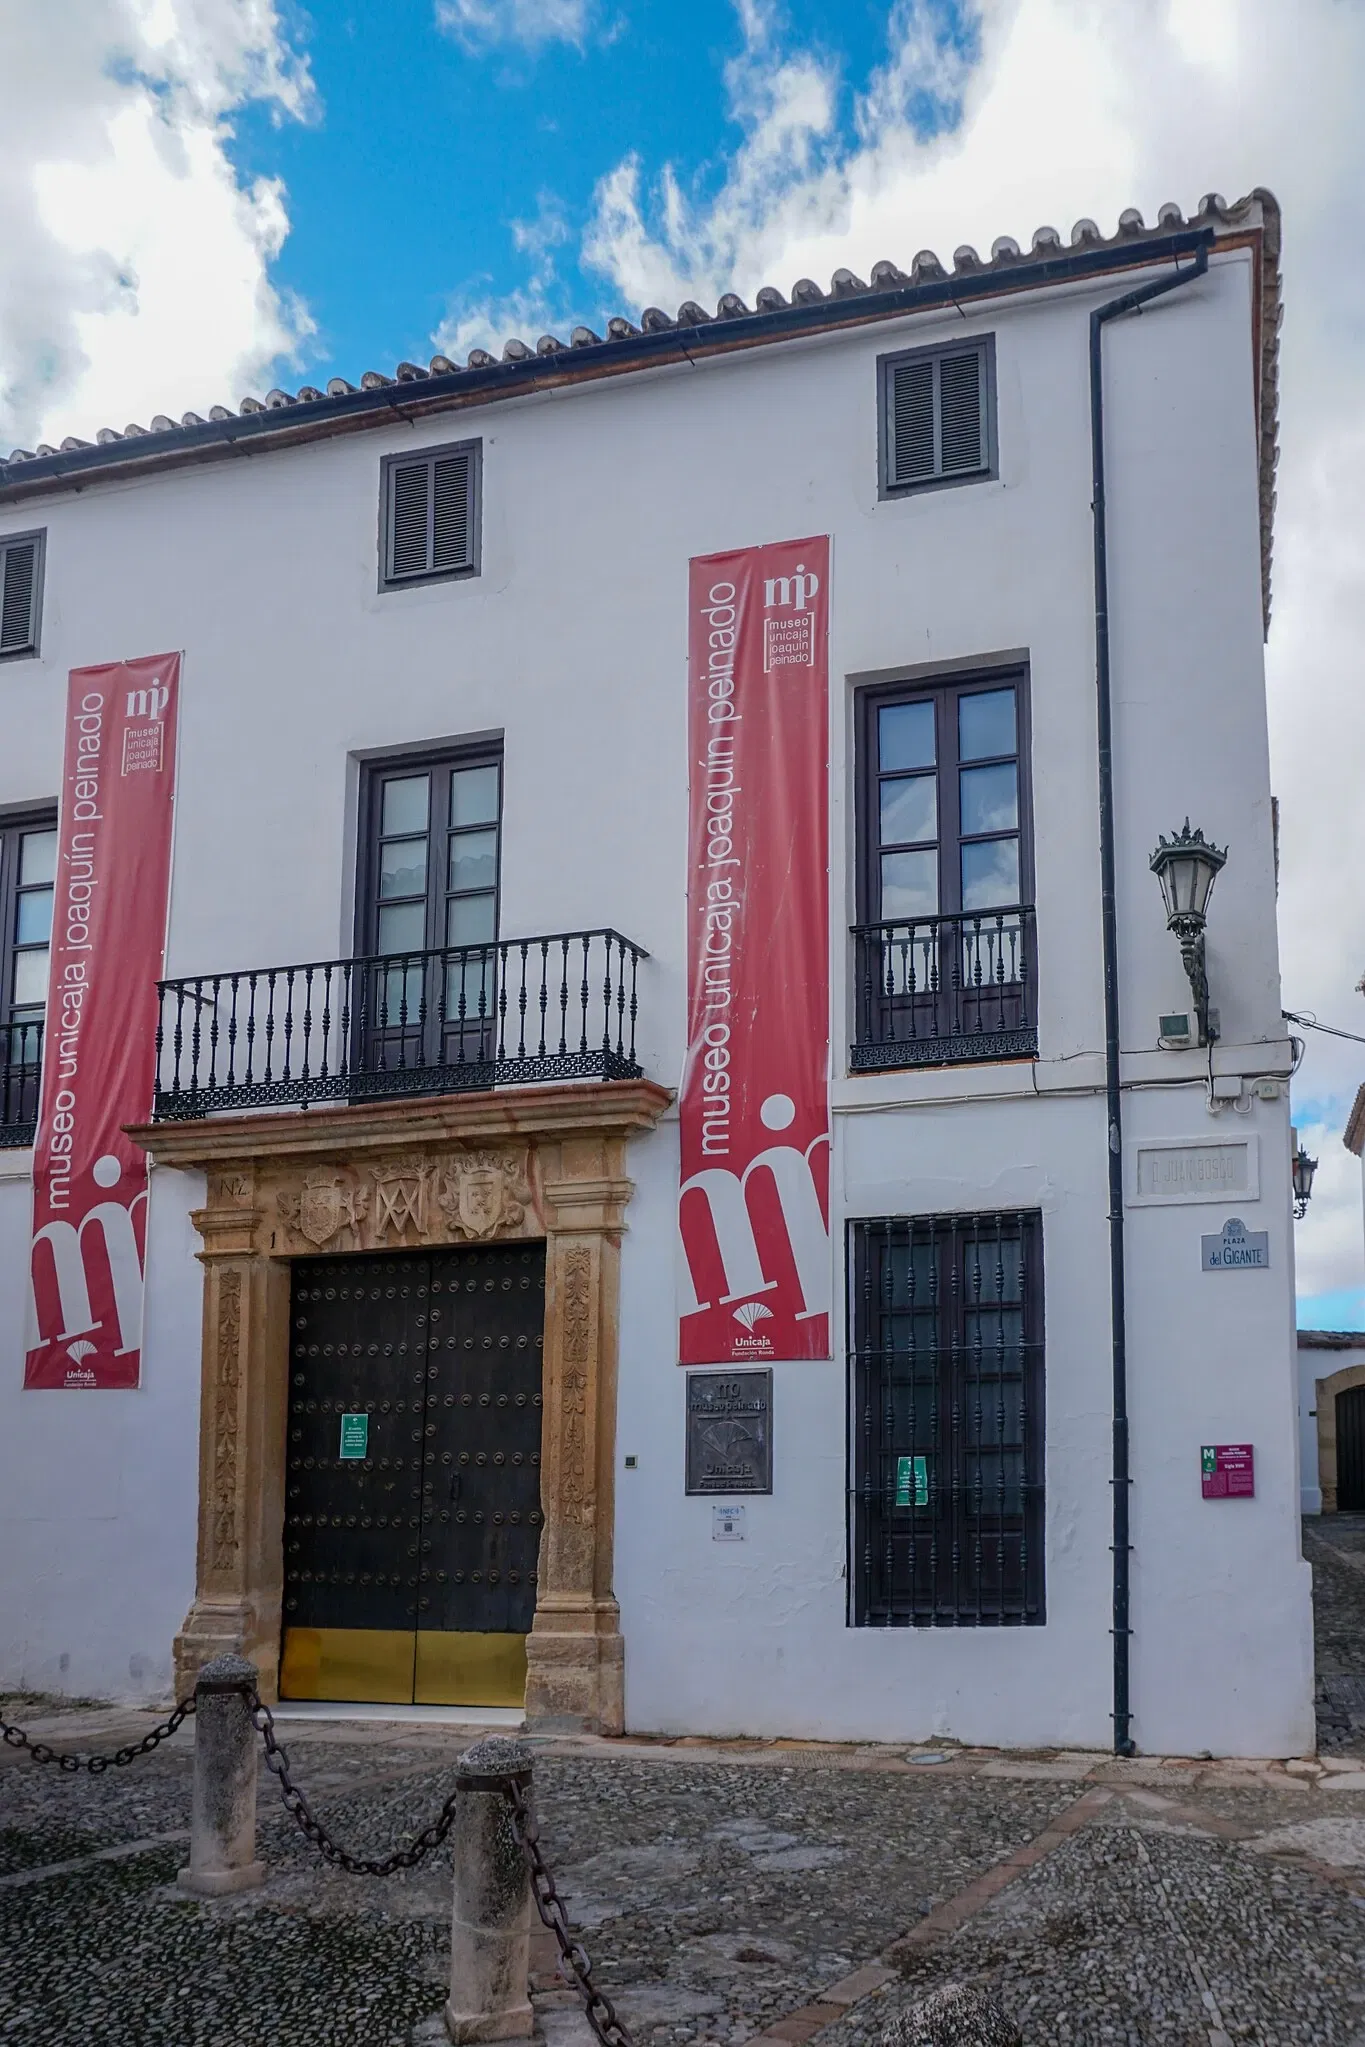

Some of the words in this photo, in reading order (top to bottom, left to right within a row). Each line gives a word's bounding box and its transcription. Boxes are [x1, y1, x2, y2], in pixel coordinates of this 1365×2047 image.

[769, 617, 809, 630] museo
[769, 627, 809, 642] unicaja
[700, 582, 742, 724] peinado
[768, 653, 809, 669] peinado
[128, 726, 159, 739] museo
[127, 736, 159, 750] unicaja
[69, 692, 104, 821] peinado
[125, 758, 157, 774] peinado
[698, 736, 741, 868] joaquín
[59, 833, 98, 951] joaquín
[699, 877, 740, 1009] unicaja
[54, 961, 89, 1078] unicaja
[702, 1023, 731, 1155] museo
[50, 1090, 75, 1209] museo
[1164, 1159, 1193, 1182] JUAN
[1198, 1157, 1234, 1180] BOSCO
[270, 1231, 276, 1249] 1
[1223, 1237, 1246, 1245] PLAZA
[1209, 1251, 1222, 1265] del
[1223, 1246, 1263, 1265] GIGANTE
[735, 1335, 771, 1347] Unicaja
[66, 1369, 95, 1380] Unicaja
[1203, 1448, 1215, 1459] M
